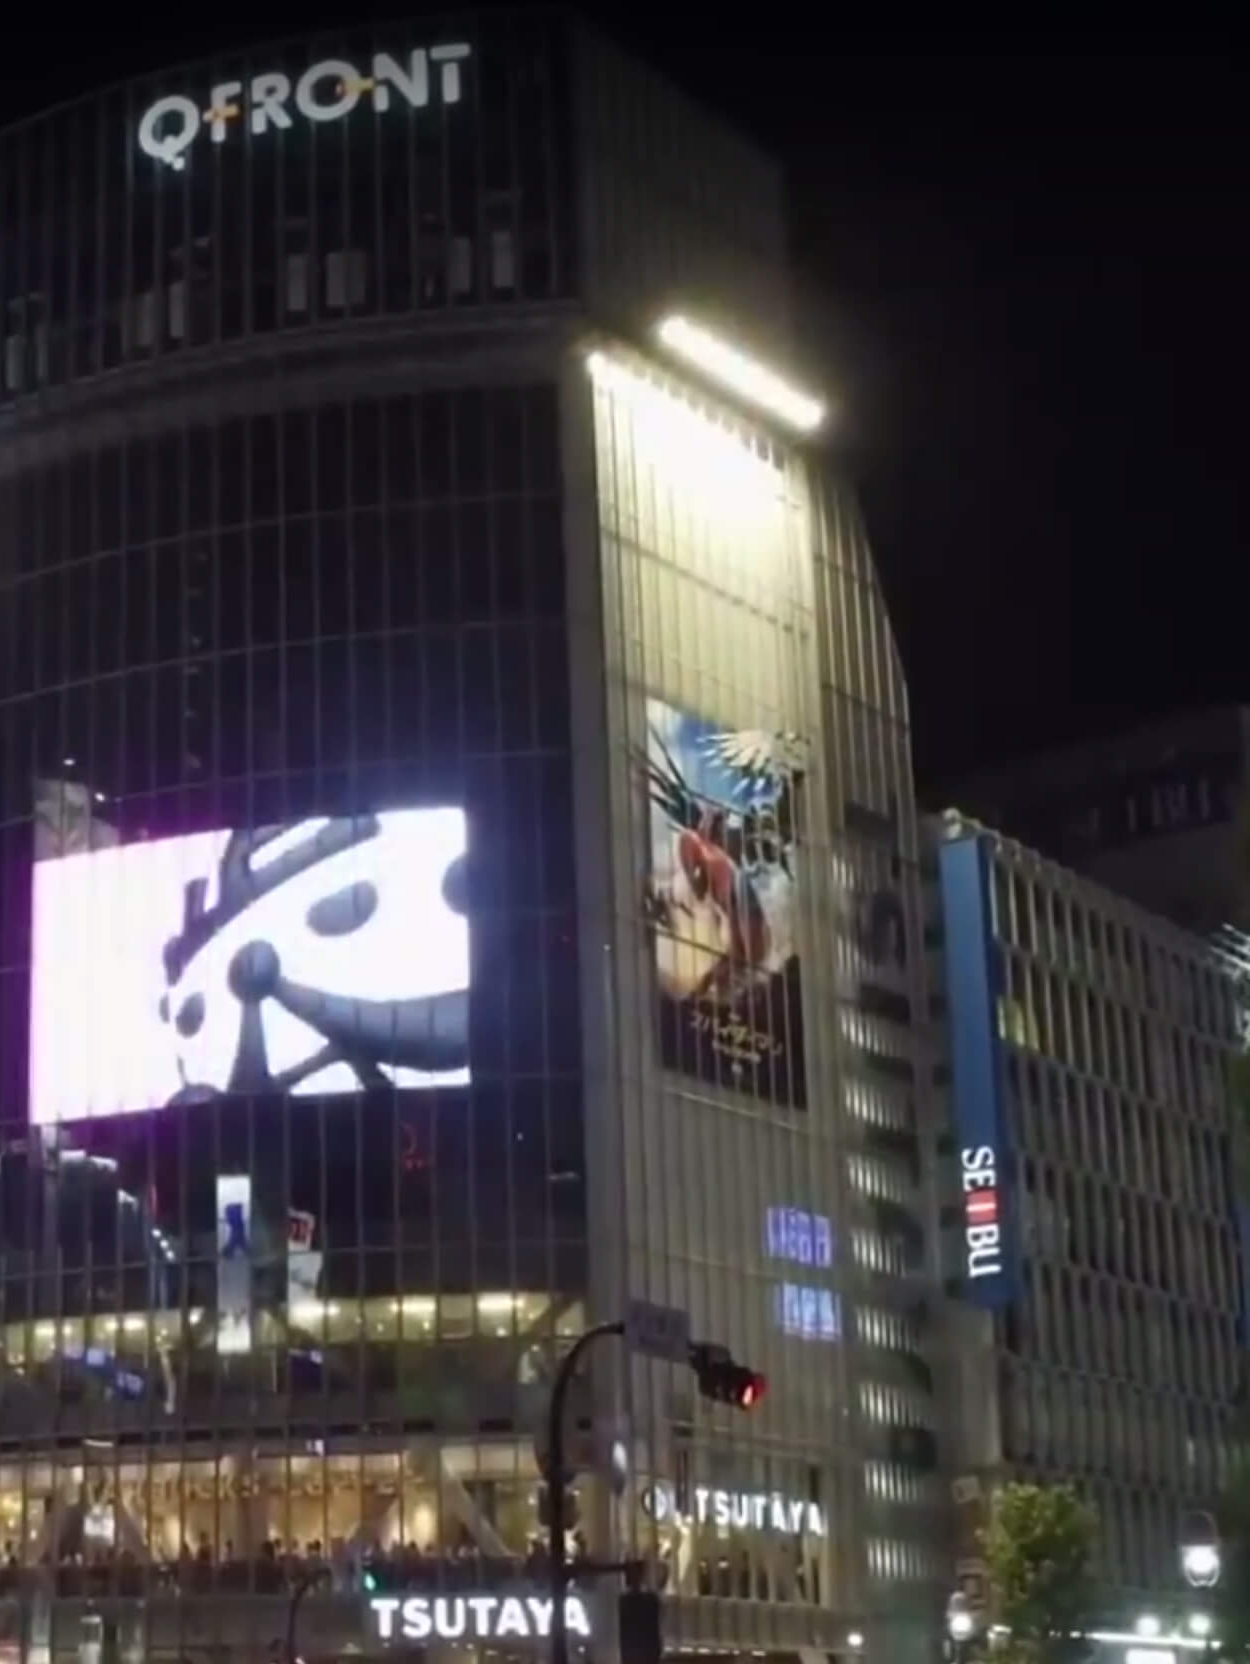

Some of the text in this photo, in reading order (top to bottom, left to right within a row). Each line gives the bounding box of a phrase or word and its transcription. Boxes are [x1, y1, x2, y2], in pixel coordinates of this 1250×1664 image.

[138, 43, 471, 171] QFRONT
[962, 1145, 1002, 1279] SEIBU
[695, 1485, 827, 1537] TSUTAYA
[370, 1596, 591, 1637] TSUTAYA
